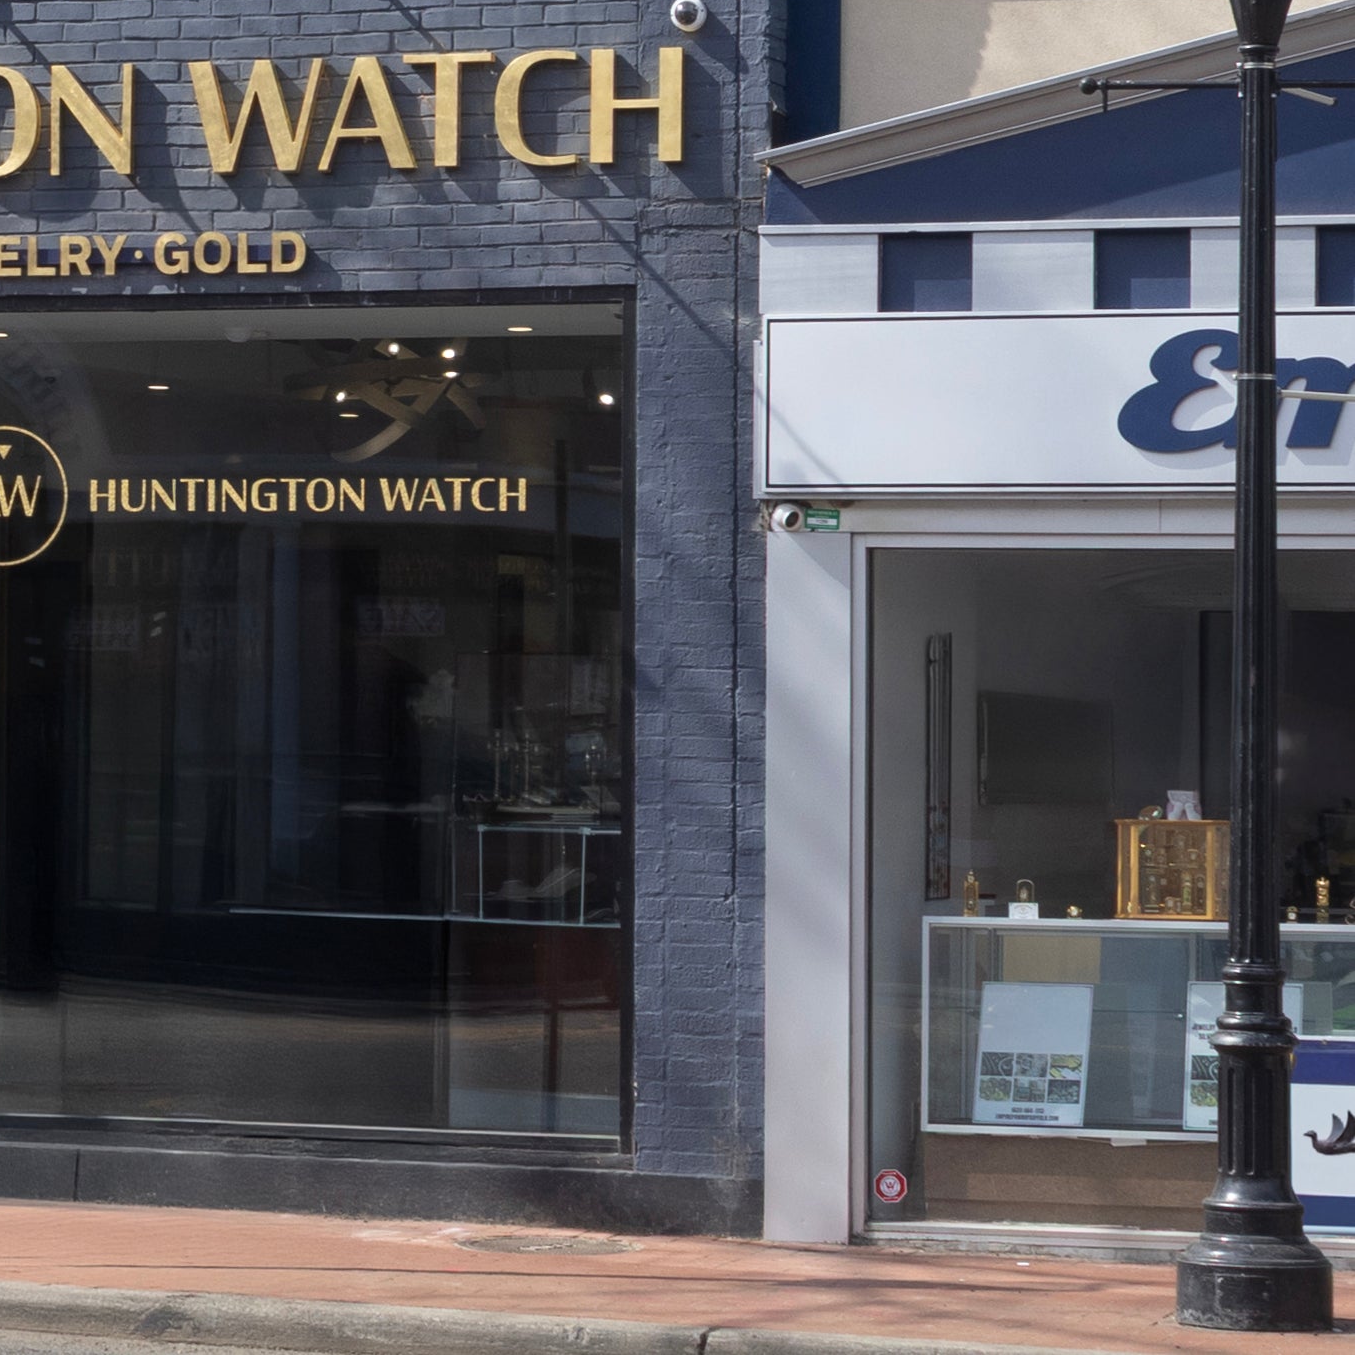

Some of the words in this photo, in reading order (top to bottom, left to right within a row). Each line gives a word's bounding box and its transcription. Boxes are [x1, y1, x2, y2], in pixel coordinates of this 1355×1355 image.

[188, 46, 684, 174] WATCH
[153, 231, 307, 275] GOLD
[88, 477, 366, 513] HUNTINGTON
[378, 476, 528, 512] WATCH
